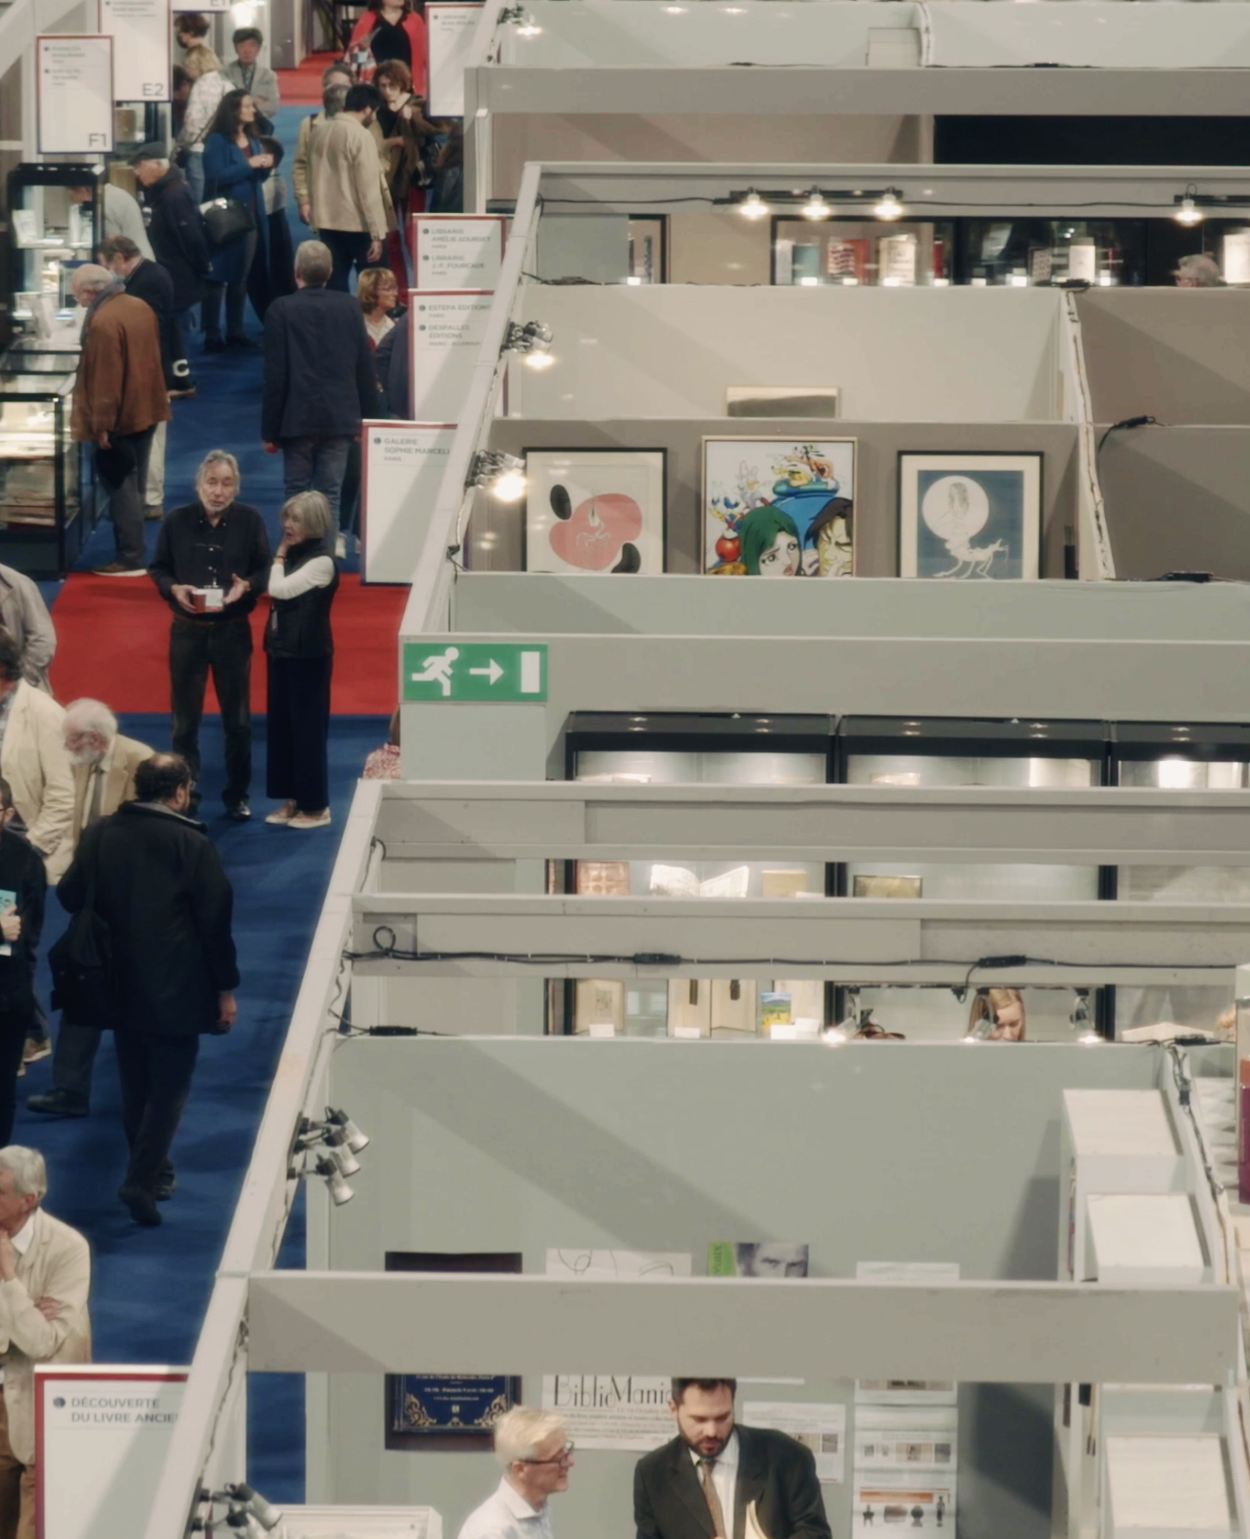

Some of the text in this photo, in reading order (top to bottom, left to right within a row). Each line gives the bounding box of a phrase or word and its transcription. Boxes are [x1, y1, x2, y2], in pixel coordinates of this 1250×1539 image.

[142, 83, 165, 97] E2
[88, 133, 107, 148] F1
[71, 1396, 160, 1409] DÉCOUVERTE
[71, 1412, 90, 1423] DU
[93, 1412, 131, 1423] LIVRE
